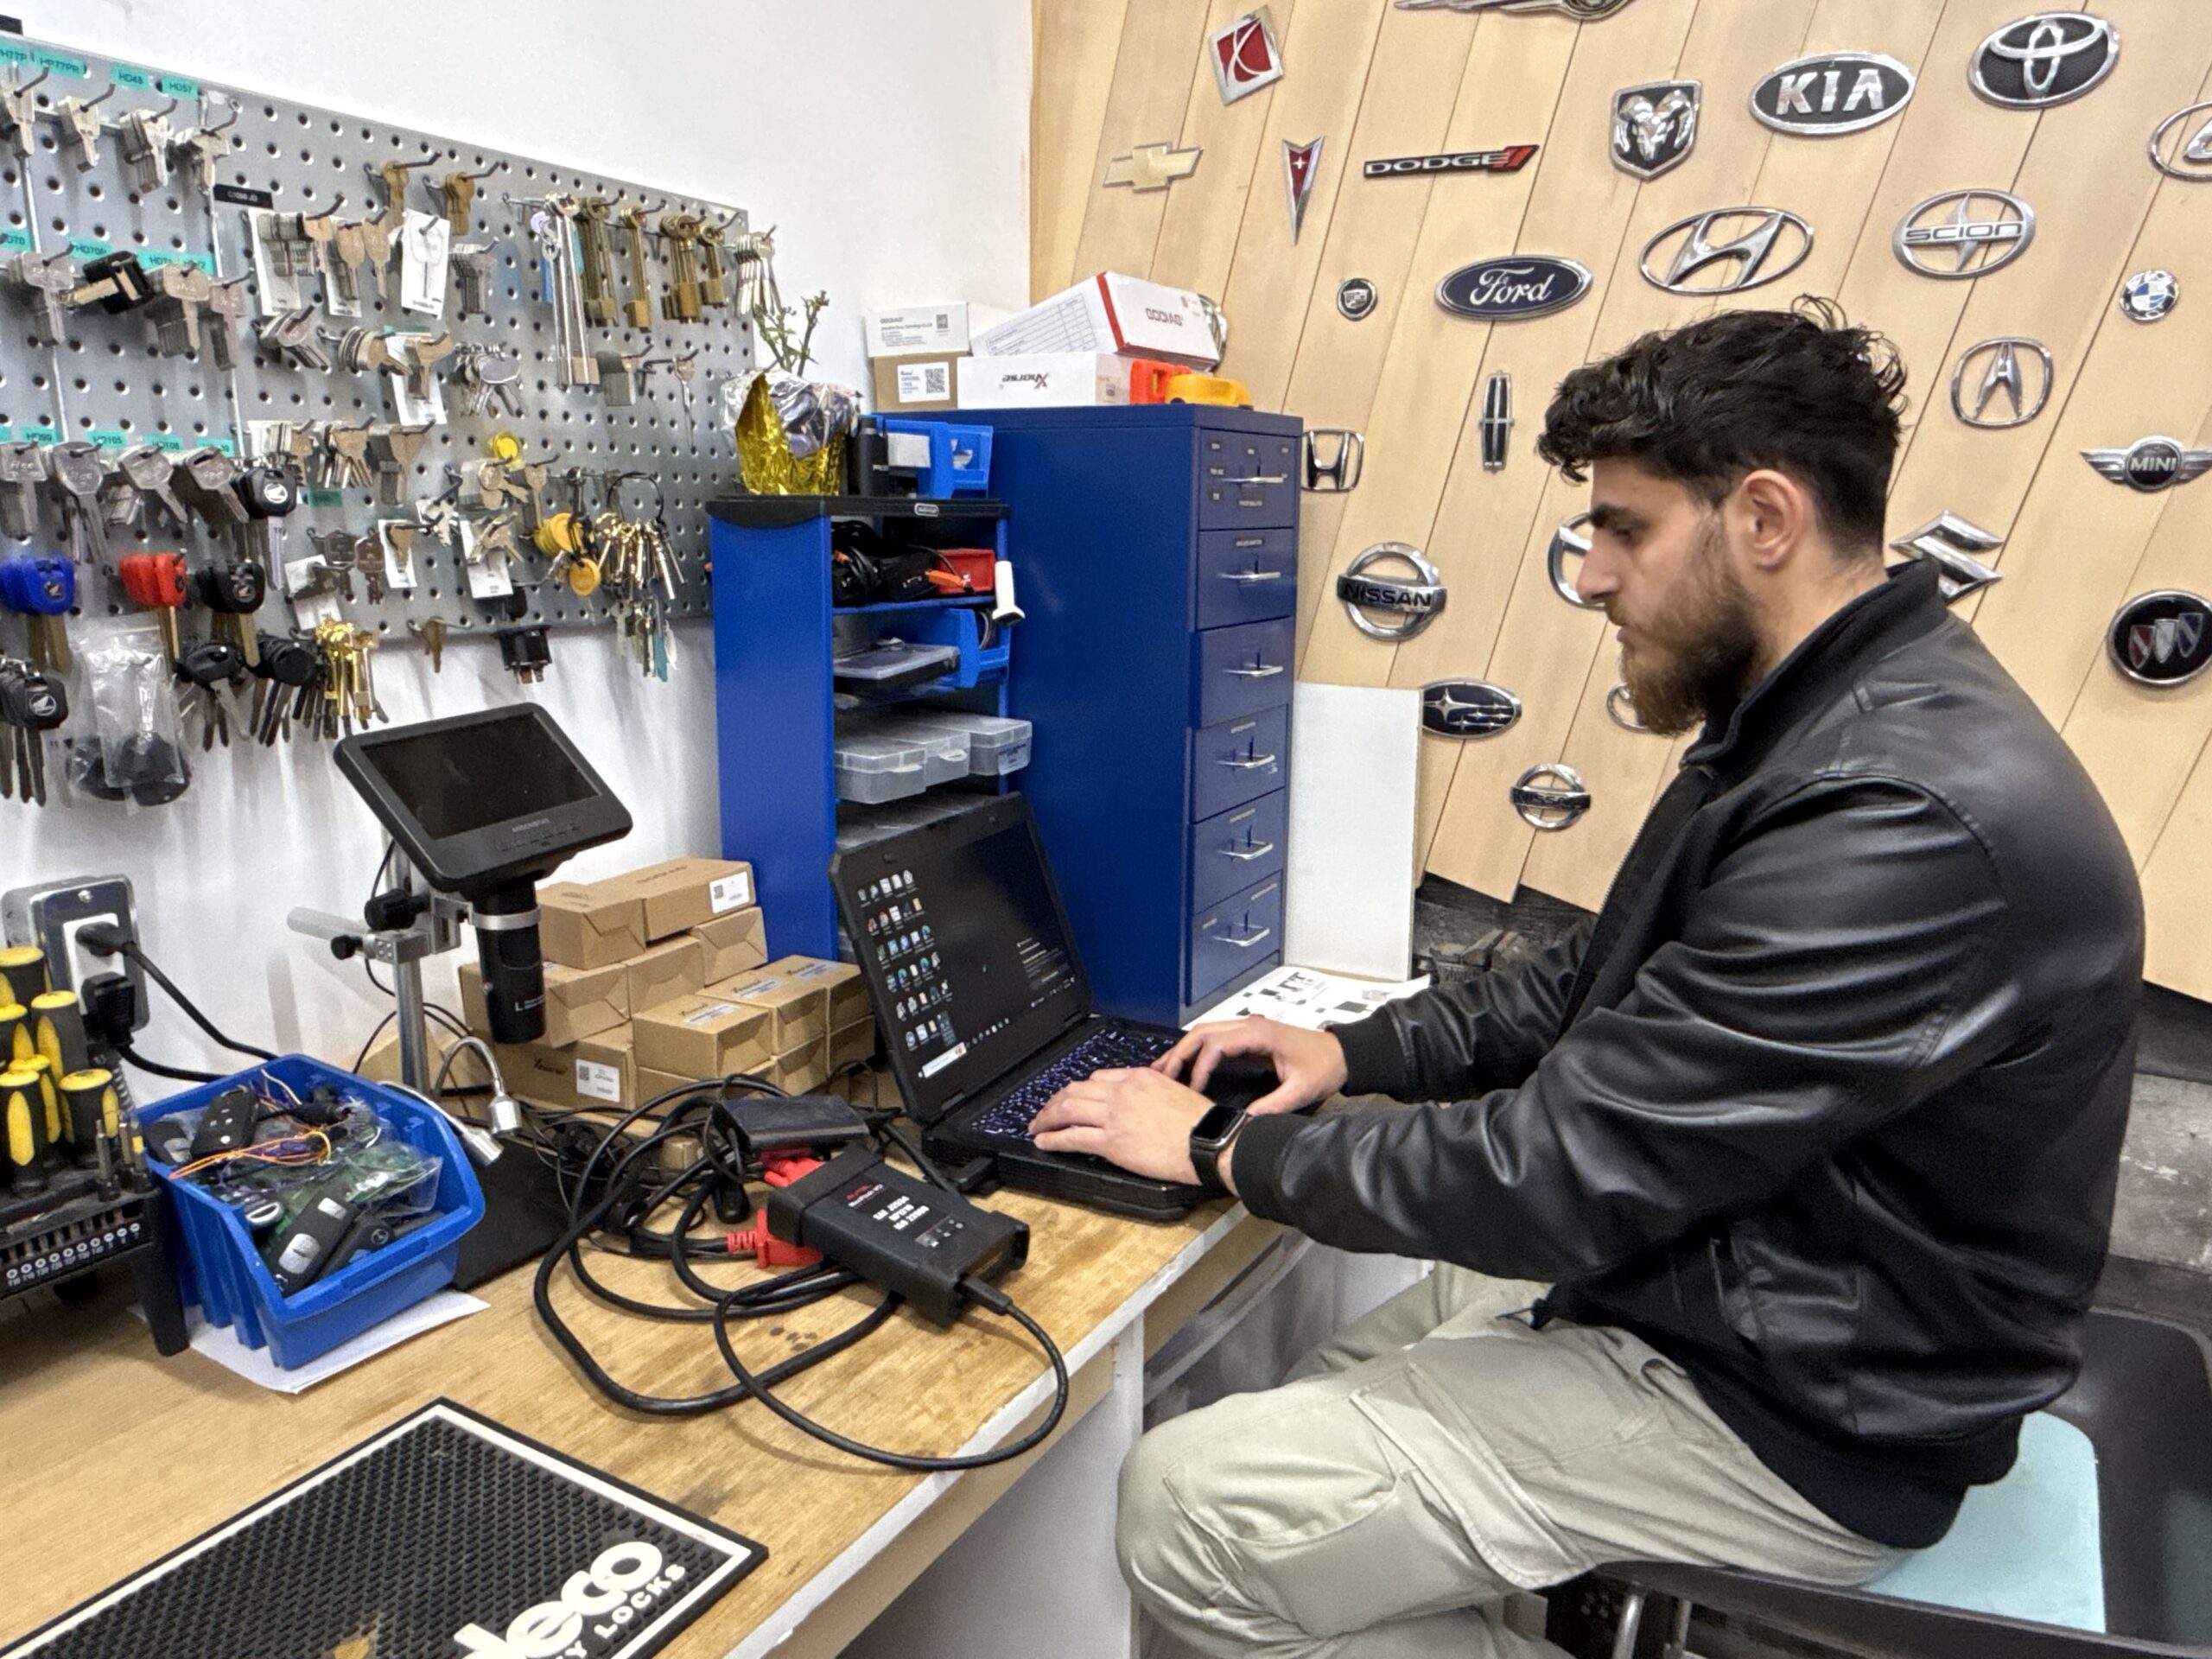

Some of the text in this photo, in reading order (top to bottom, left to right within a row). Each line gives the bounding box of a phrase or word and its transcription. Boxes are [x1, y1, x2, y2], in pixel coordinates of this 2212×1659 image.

[1776, 68, 1885, 116] KIA
[1365, 152, 1511, 175] DODGE
[1905, 223, 2023, 242] SCION
[1469, 266, 1555, 306] Ford
[2129, 456, 2177, 472] MINI
[1344, 583, 1433, 607] NISSAN
[594, 1564, 686, 1639] LOCKS
